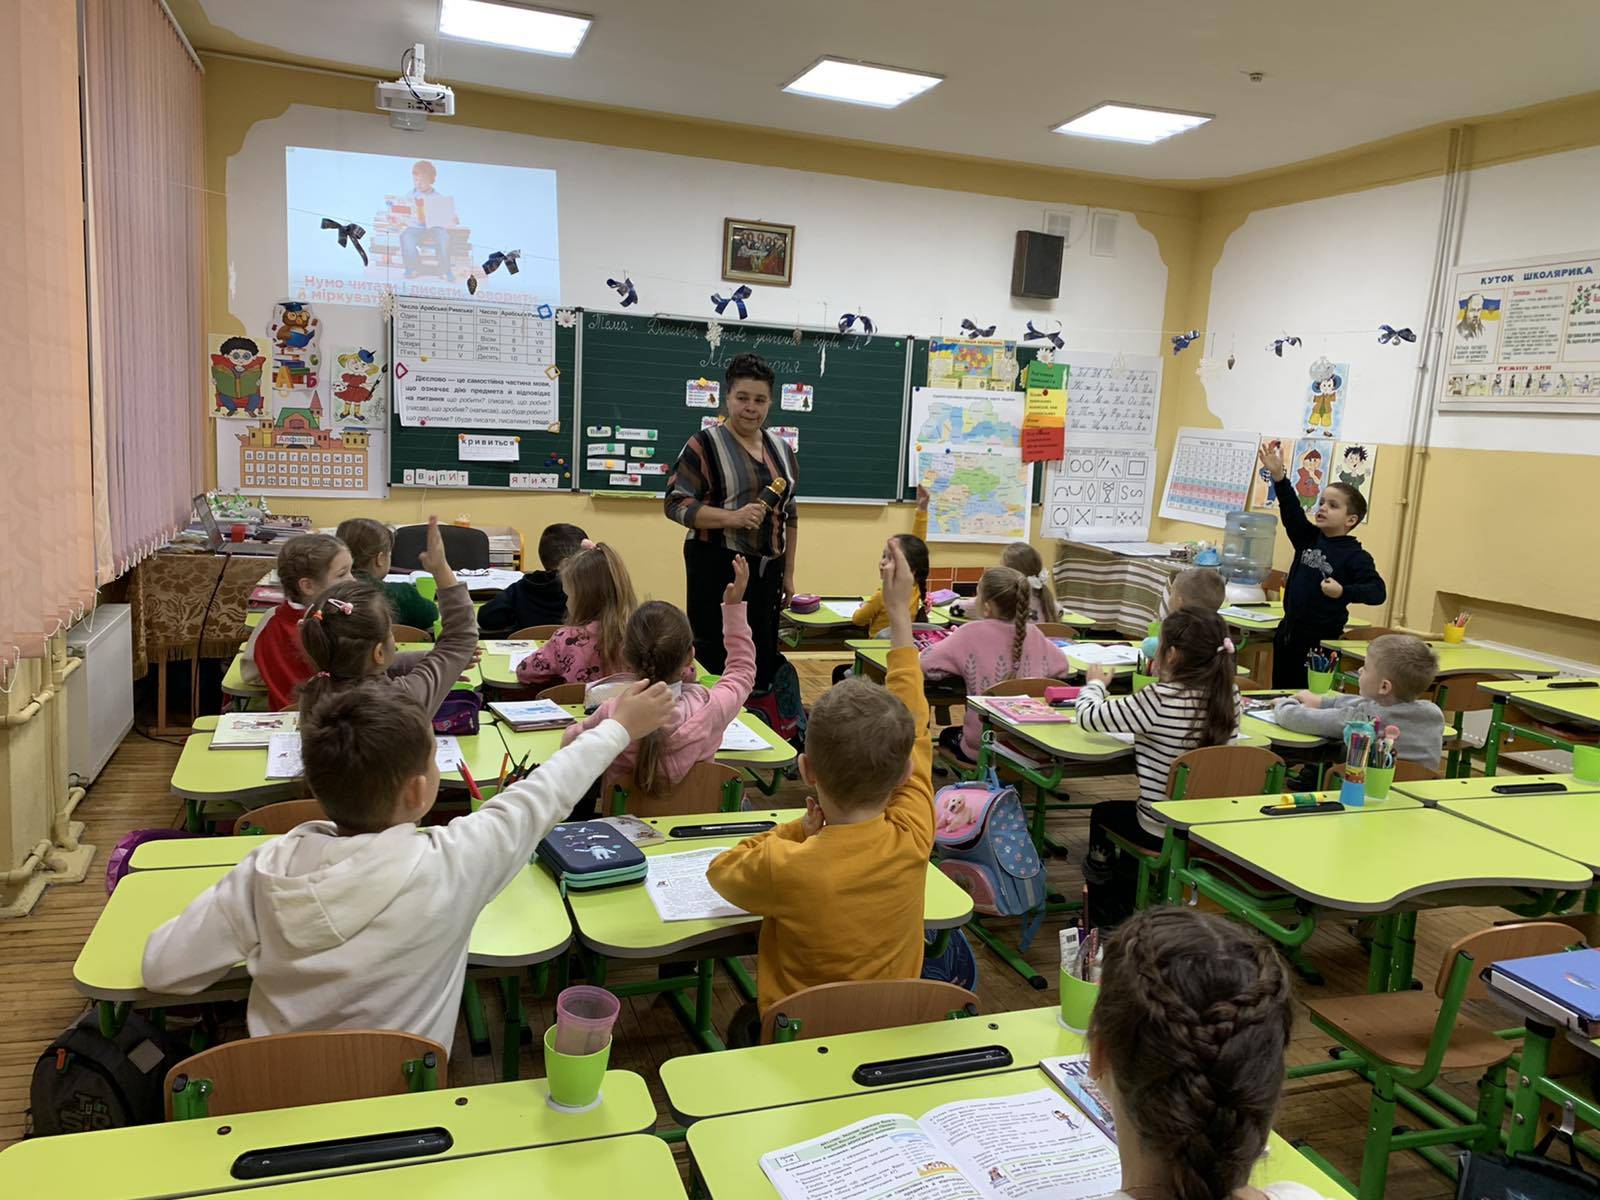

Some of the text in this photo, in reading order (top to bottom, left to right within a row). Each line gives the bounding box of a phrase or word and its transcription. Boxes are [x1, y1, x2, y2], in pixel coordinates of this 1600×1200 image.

[305, 275, 344, 289] Нумо
[1480, 266, 1594, 285] КУТОК ШКОЛЯРИКА
[306, 371, 318, 388] Б
[415, 375, 447, 383] Дієслово
[466, 378, 504, 386] самостійна
[277, 435, 313, 444] Алфавіт
